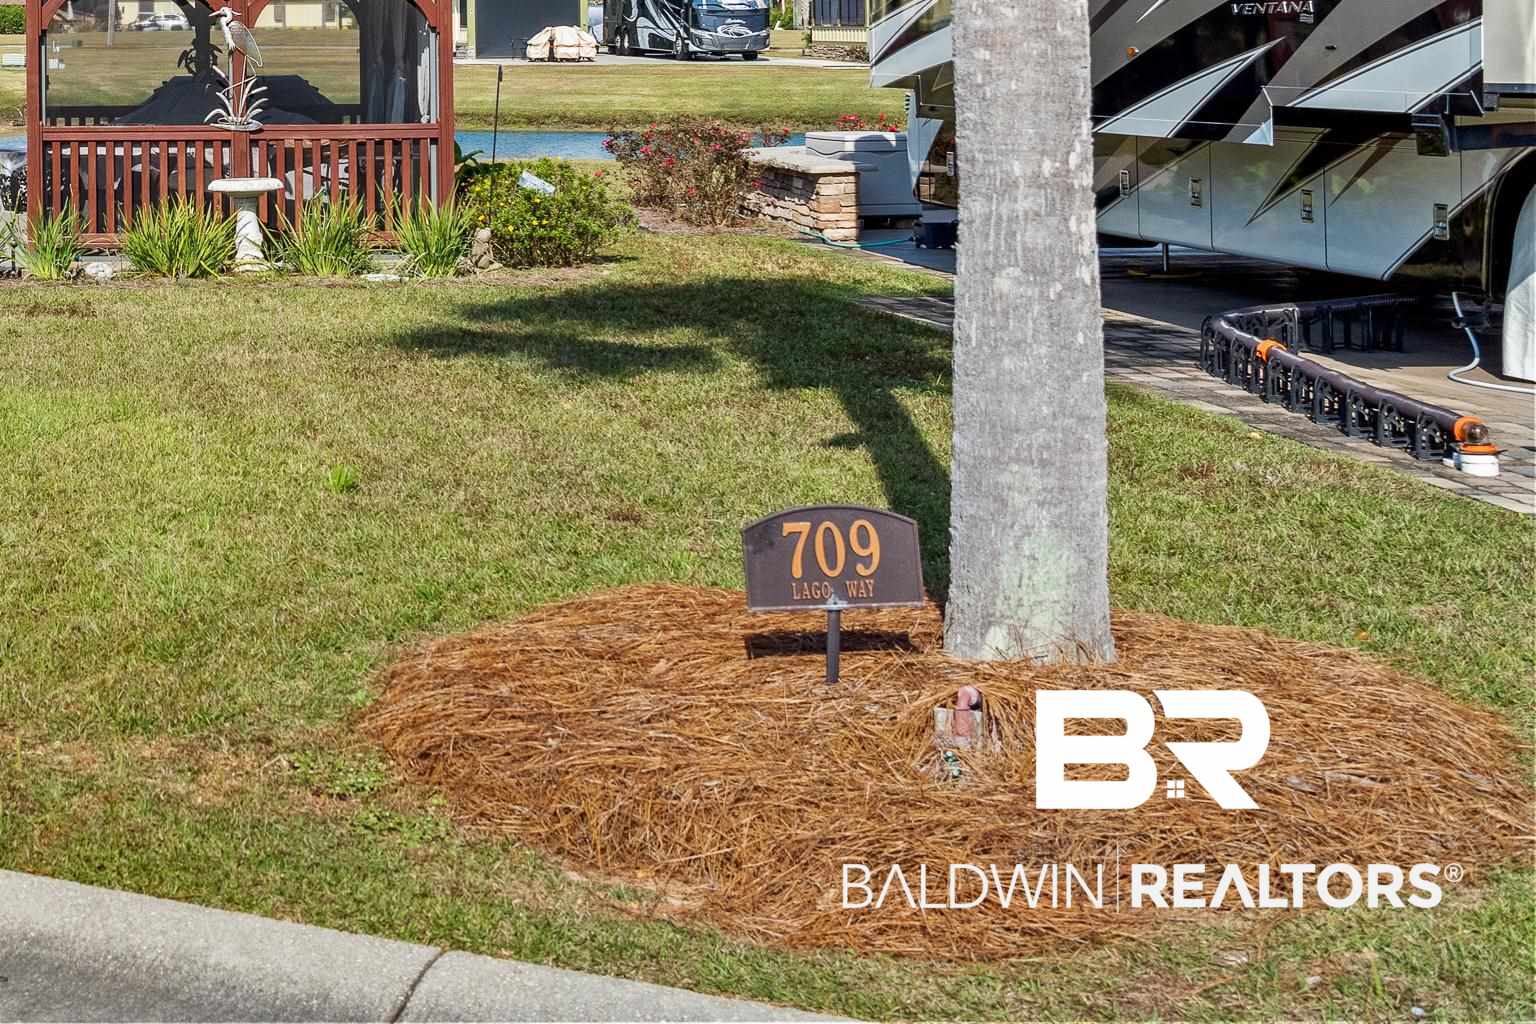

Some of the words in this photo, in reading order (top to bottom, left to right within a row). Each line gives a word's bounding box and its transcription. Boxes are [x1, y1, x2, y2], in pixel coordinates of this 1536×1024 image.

[1231, 0, 1314, 15] VENTANA
[782, 519, 881, 579] 709
[792, 582, 832, 600] LAGO
[846, 579, 875, 598] WAY
